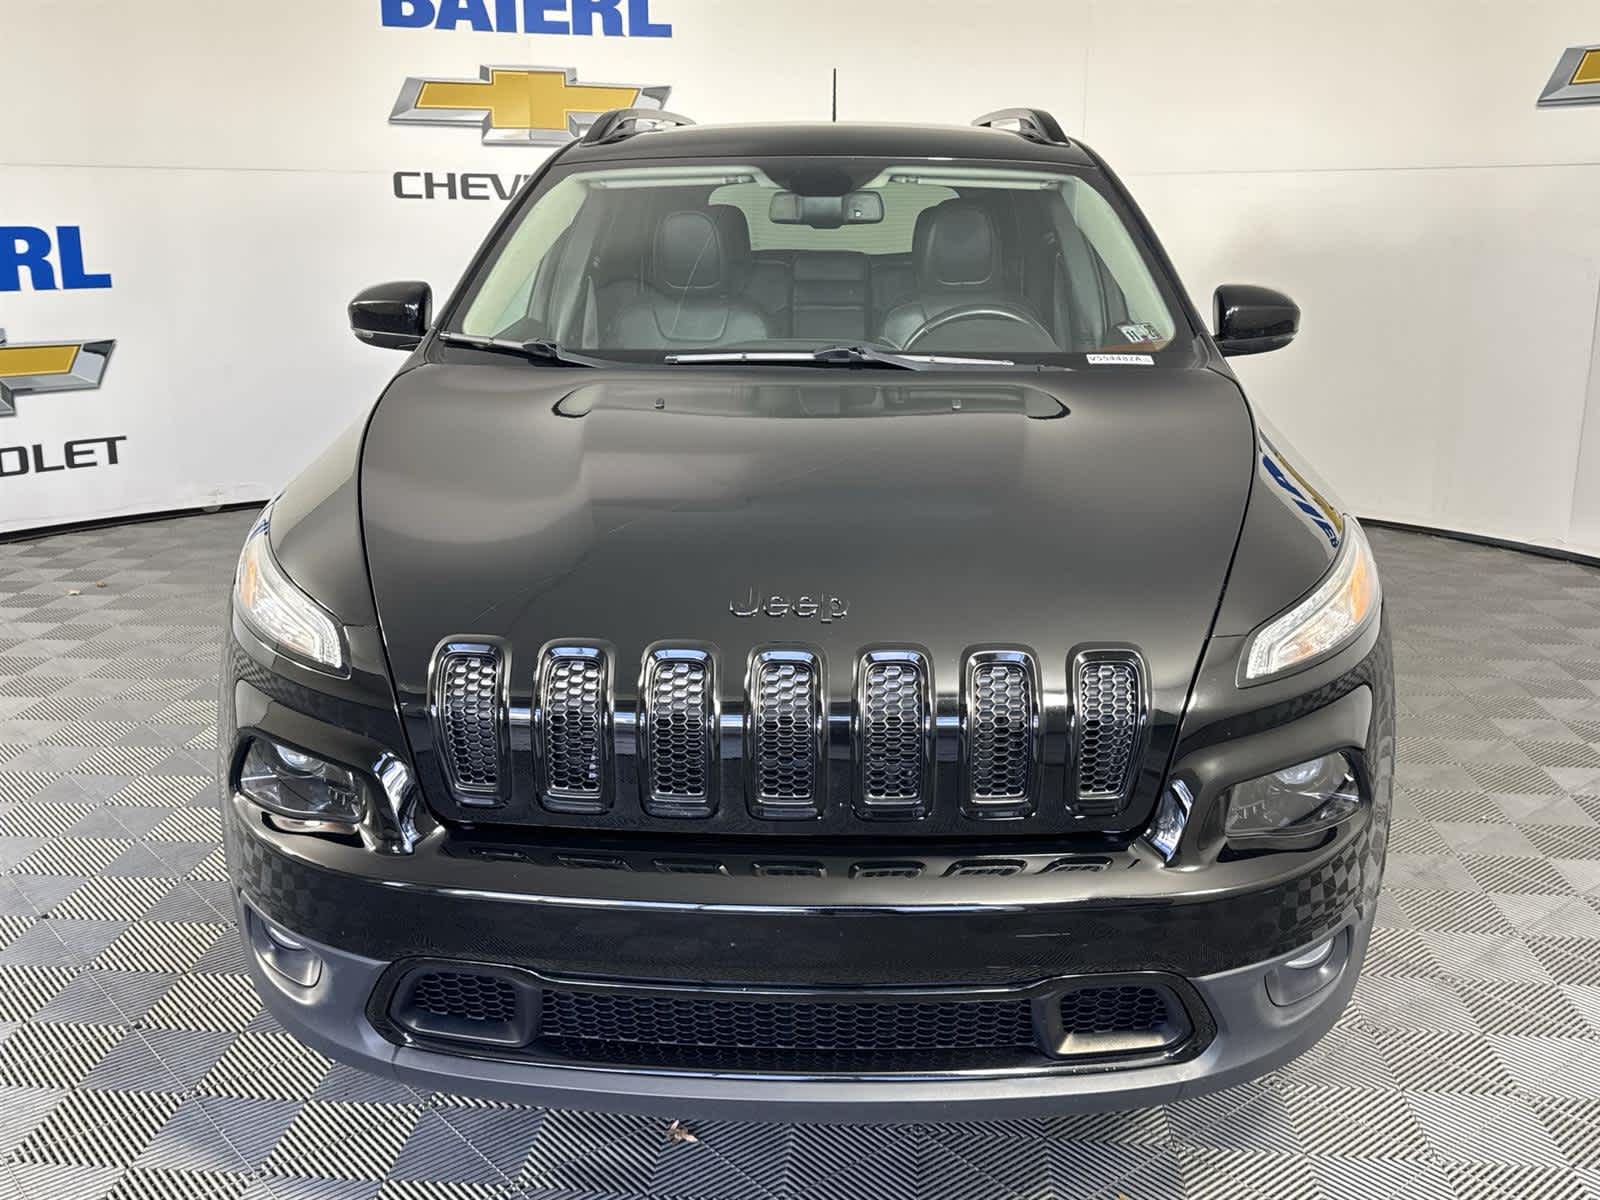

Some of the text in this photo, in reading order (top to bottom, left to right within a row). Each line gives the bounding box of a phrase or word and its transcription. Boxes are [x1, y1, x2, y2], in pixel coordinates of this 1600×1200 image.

[380, 0, 672, 38] BAIERL
[393, 171, 530, 200] CHEV
[729, 585, 848, 624] Jeep
